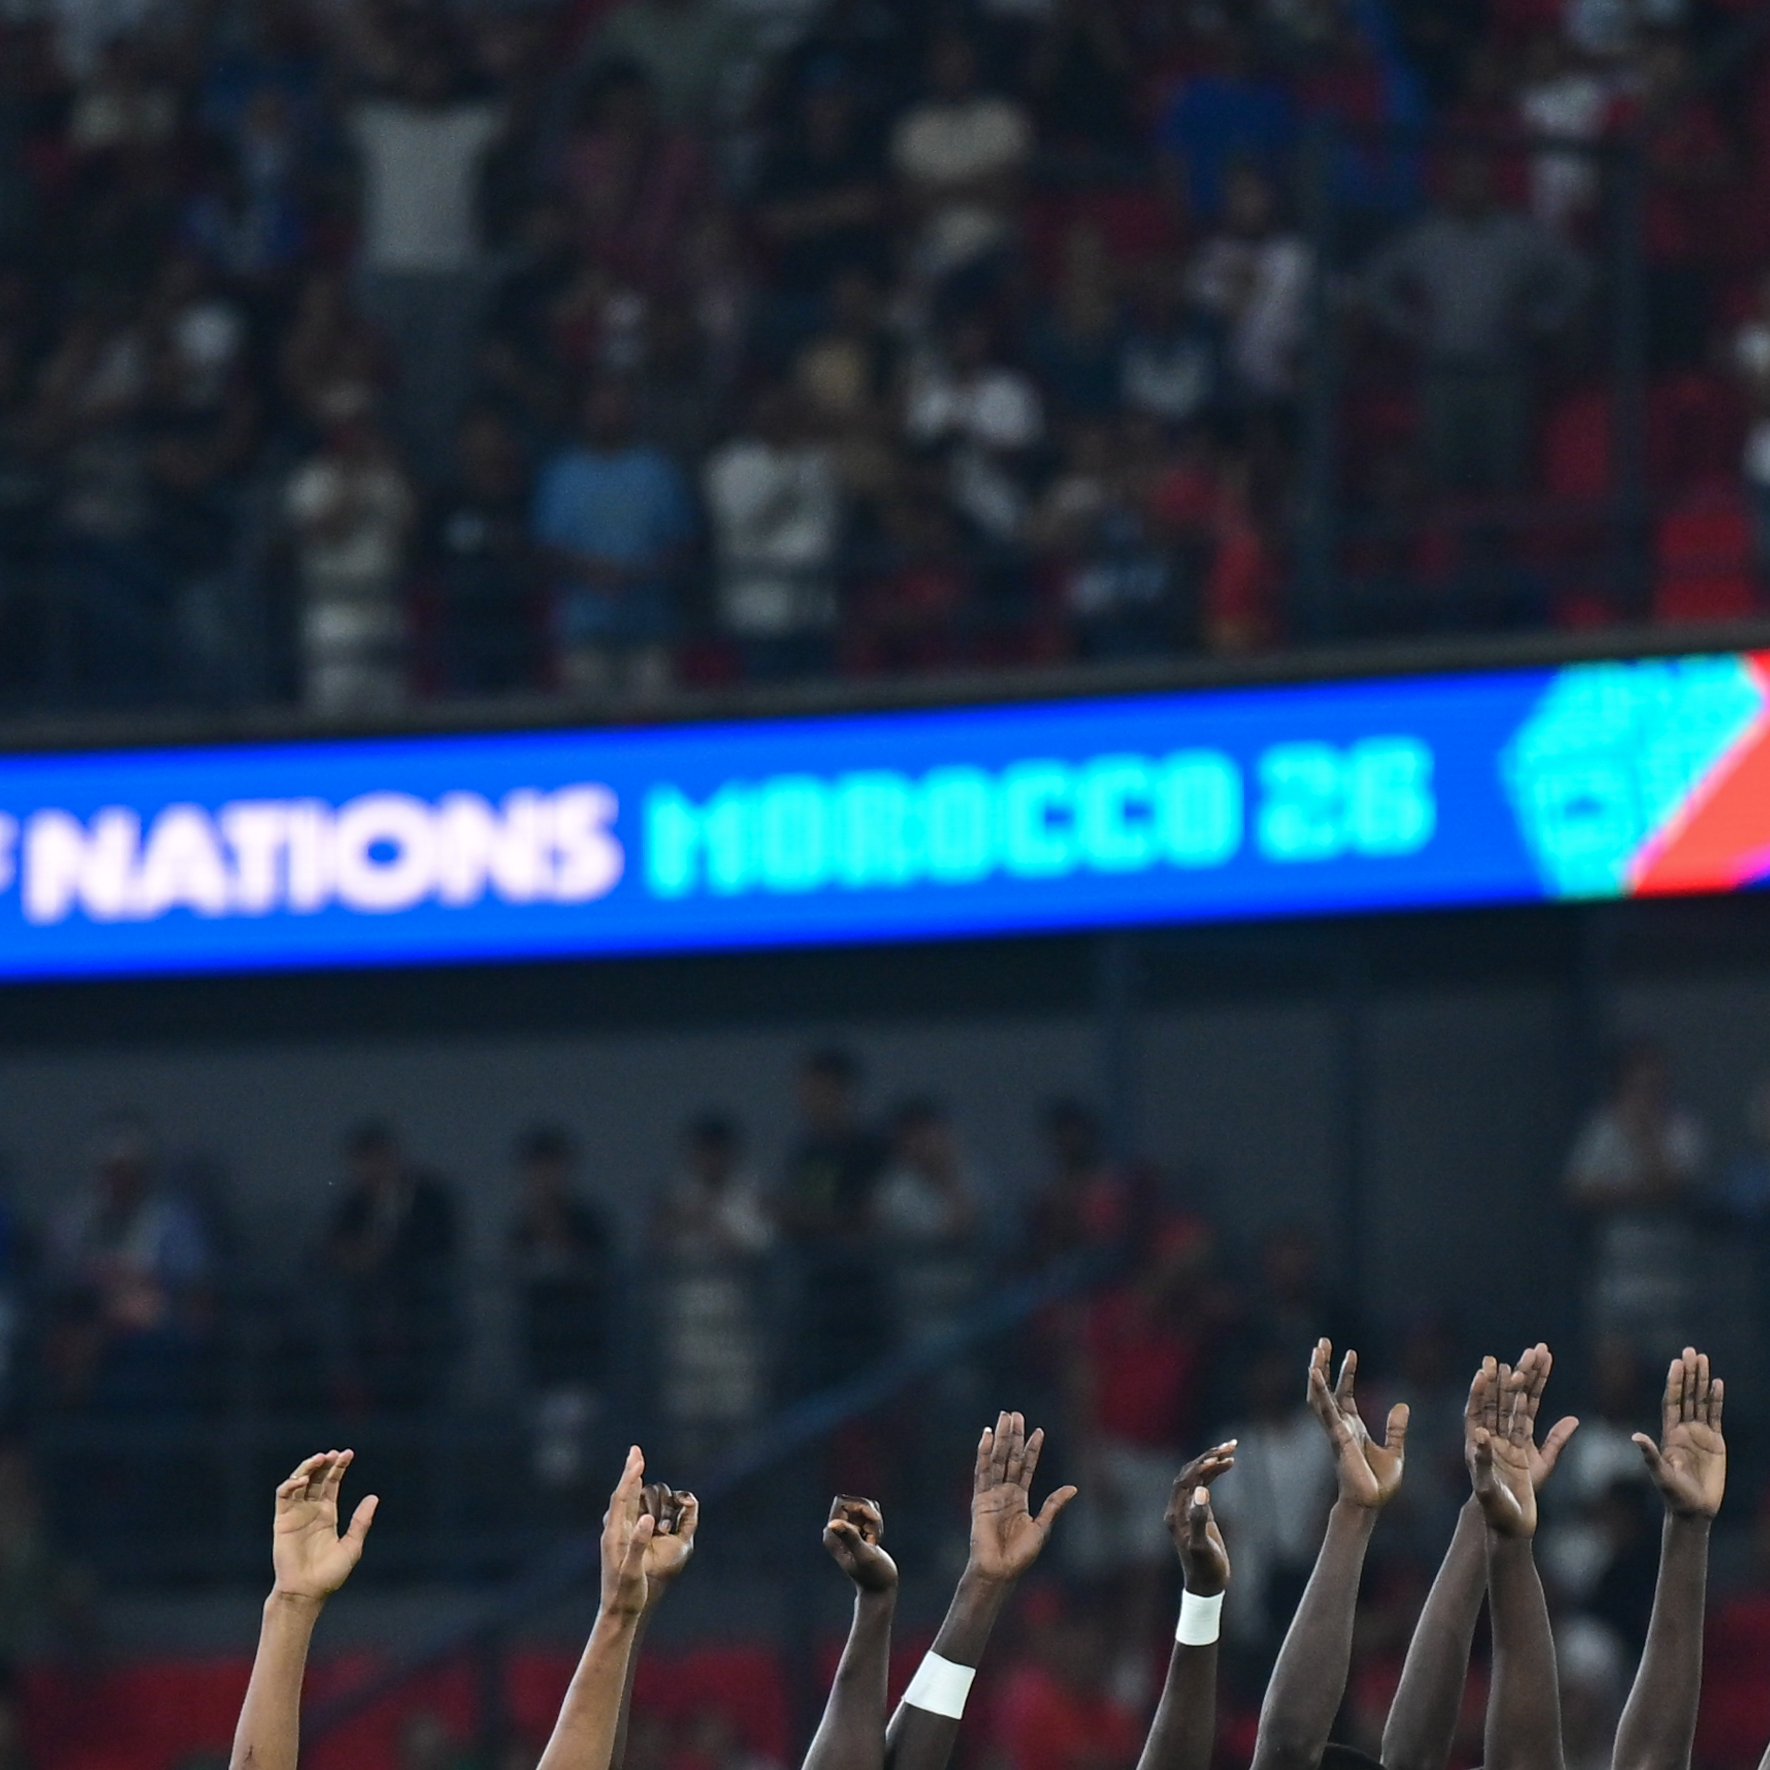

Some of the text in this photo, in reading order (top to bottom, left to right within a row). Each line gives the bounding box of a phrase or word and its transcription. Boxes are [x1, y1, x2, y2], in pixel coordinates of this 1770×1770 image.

[21, 781, 624, 926] NATIONS
[644, 747, 1243, 899] MOROCCO
[1255, 735, 1434, 863] 26
